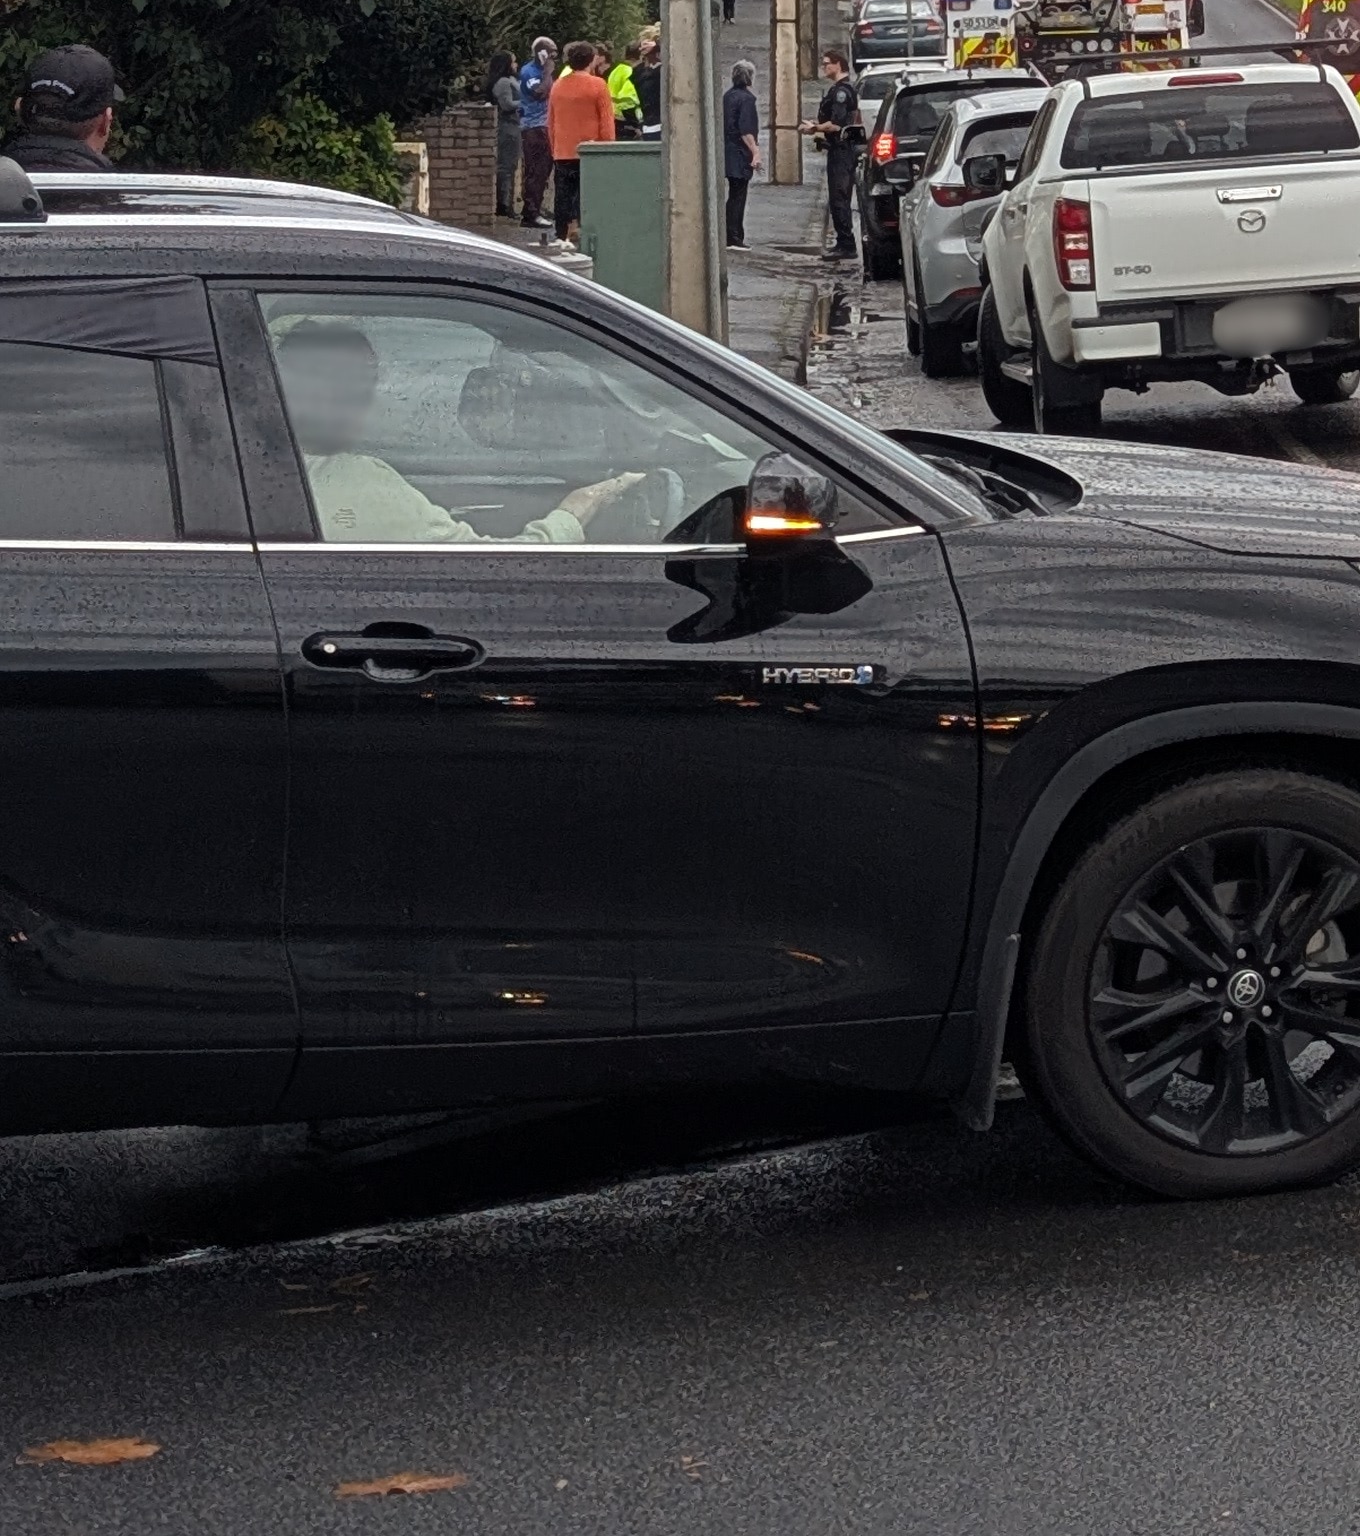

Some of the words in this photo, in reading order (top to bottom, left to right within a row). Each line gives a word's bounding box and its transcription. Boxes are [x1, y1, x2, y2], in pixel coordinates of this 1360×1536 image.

[1321, 0, 1346, 13] 340
[1114, 265, 1152, 276] BT-50
[762, 667, 856, 684] HYBRID
